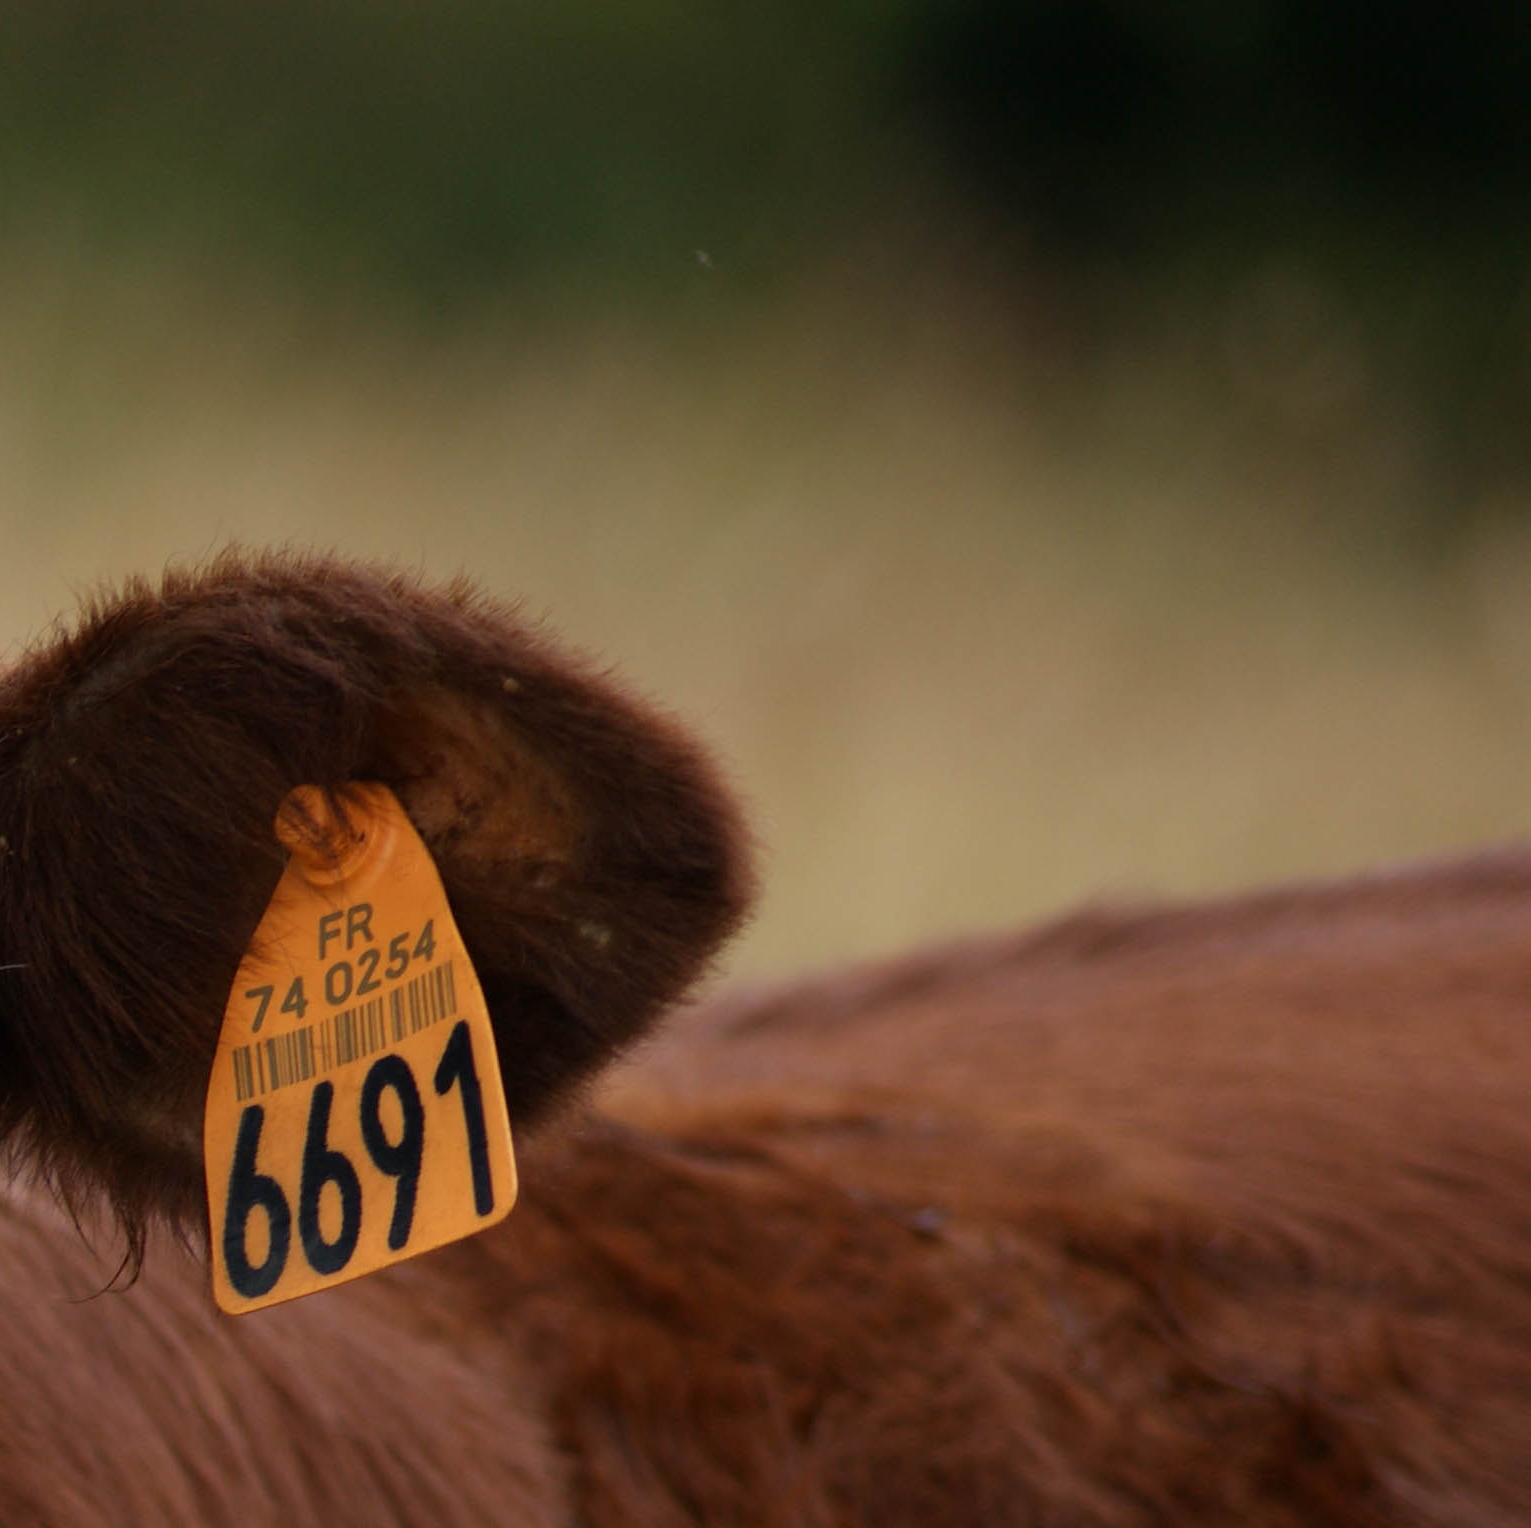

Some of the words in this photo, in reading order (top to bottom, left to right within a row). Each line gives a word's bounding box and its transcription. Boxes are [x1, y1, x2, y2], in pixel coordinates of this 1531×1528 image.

[245, 976, 308, 1033] 74
[325, 918, 436, 1006] 0254
[318, 903, 374, 960] FR
[223, 1020, 494, 1298] 6691
